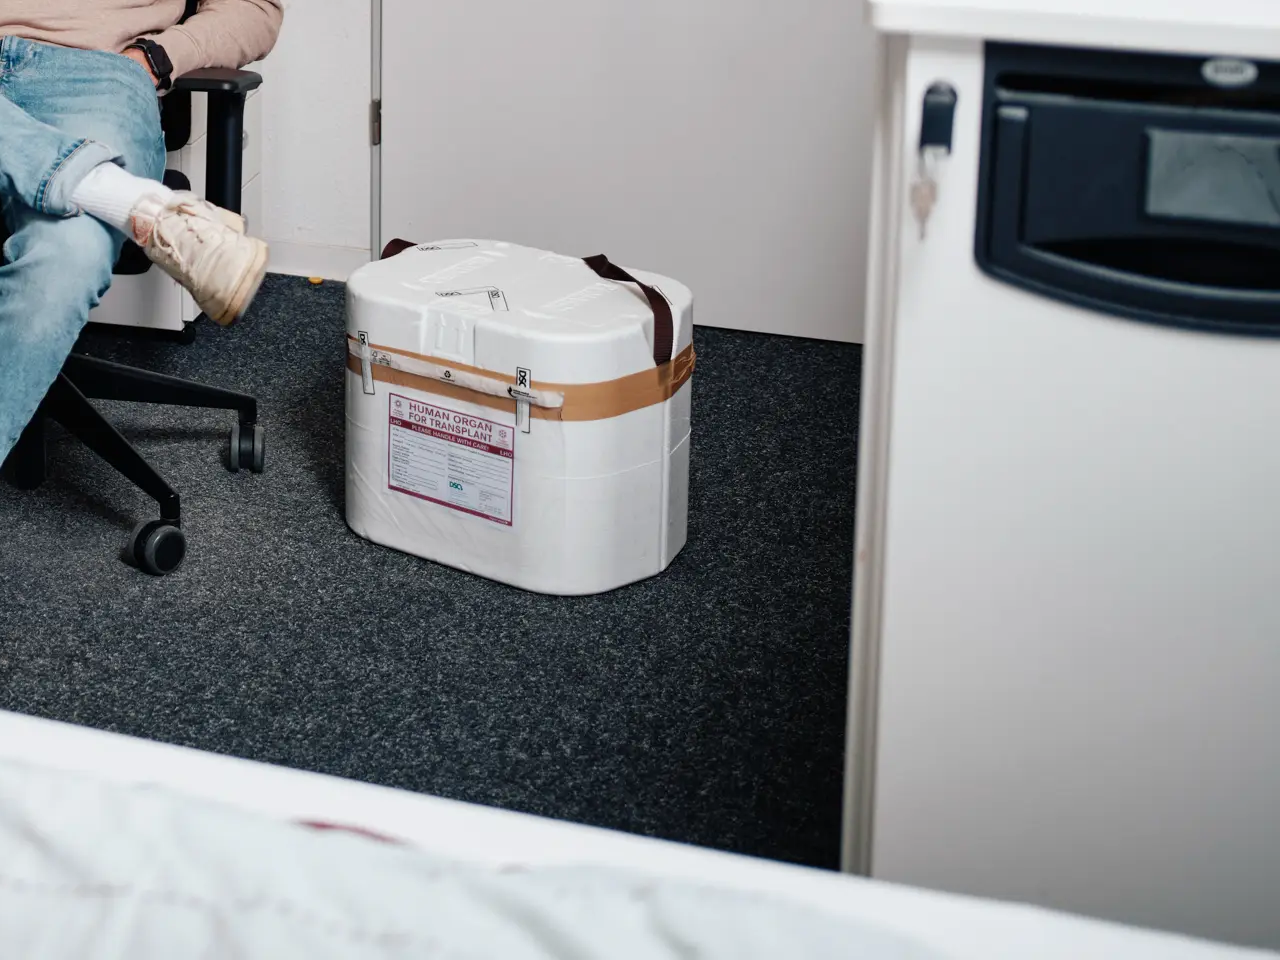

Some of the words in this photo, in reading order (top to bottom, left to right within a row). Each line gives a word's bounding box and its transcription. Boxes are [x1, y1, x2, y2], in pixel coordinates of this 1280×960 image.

[408, 412, 427, 425] FOR
[429, 418, 493, 443] TRANSPLANT
[409, 402, 450, 421] HUMAN
[453, 414, 493, 434] ORGAN
[411, 424, 432, 436] PLEASE
[433, 429, 456, 442] HANDLE
[456, 436, 472, 447] WITH
[472, 440, 490, 452] CARE!
[500, 450, 513, 458] LHO
